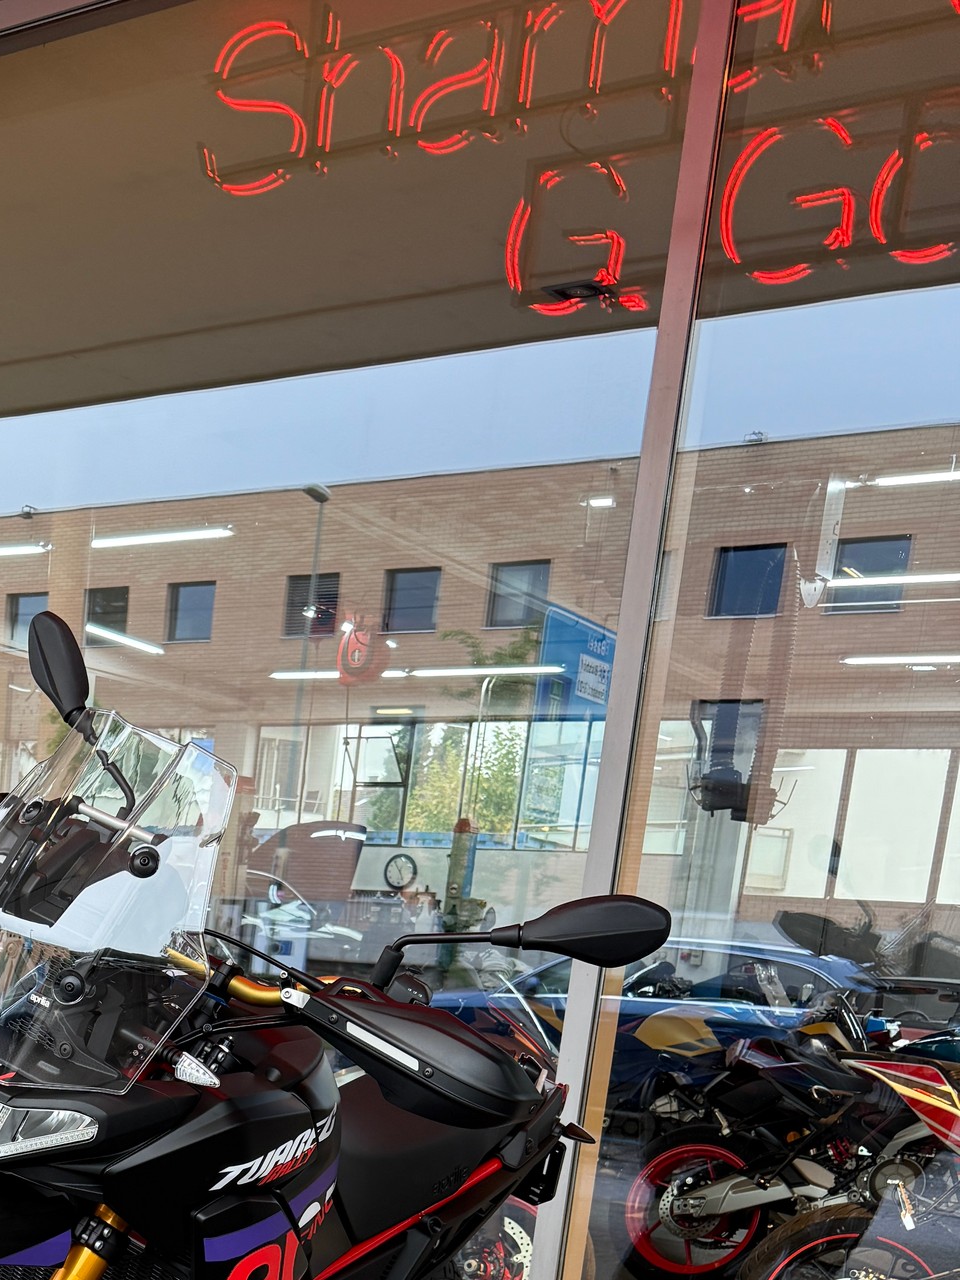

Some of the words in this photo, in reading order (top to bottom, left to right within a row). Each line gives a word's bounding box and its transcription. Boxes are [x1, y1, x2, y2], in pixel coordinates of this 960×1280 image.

[30, 994, 50, 1008] aprilia
[208, 1102, 338, 1191] TUAREG
[257, 1143, 317, 1186] RALLY
[431, 1164, 470, 1195] aprilia
